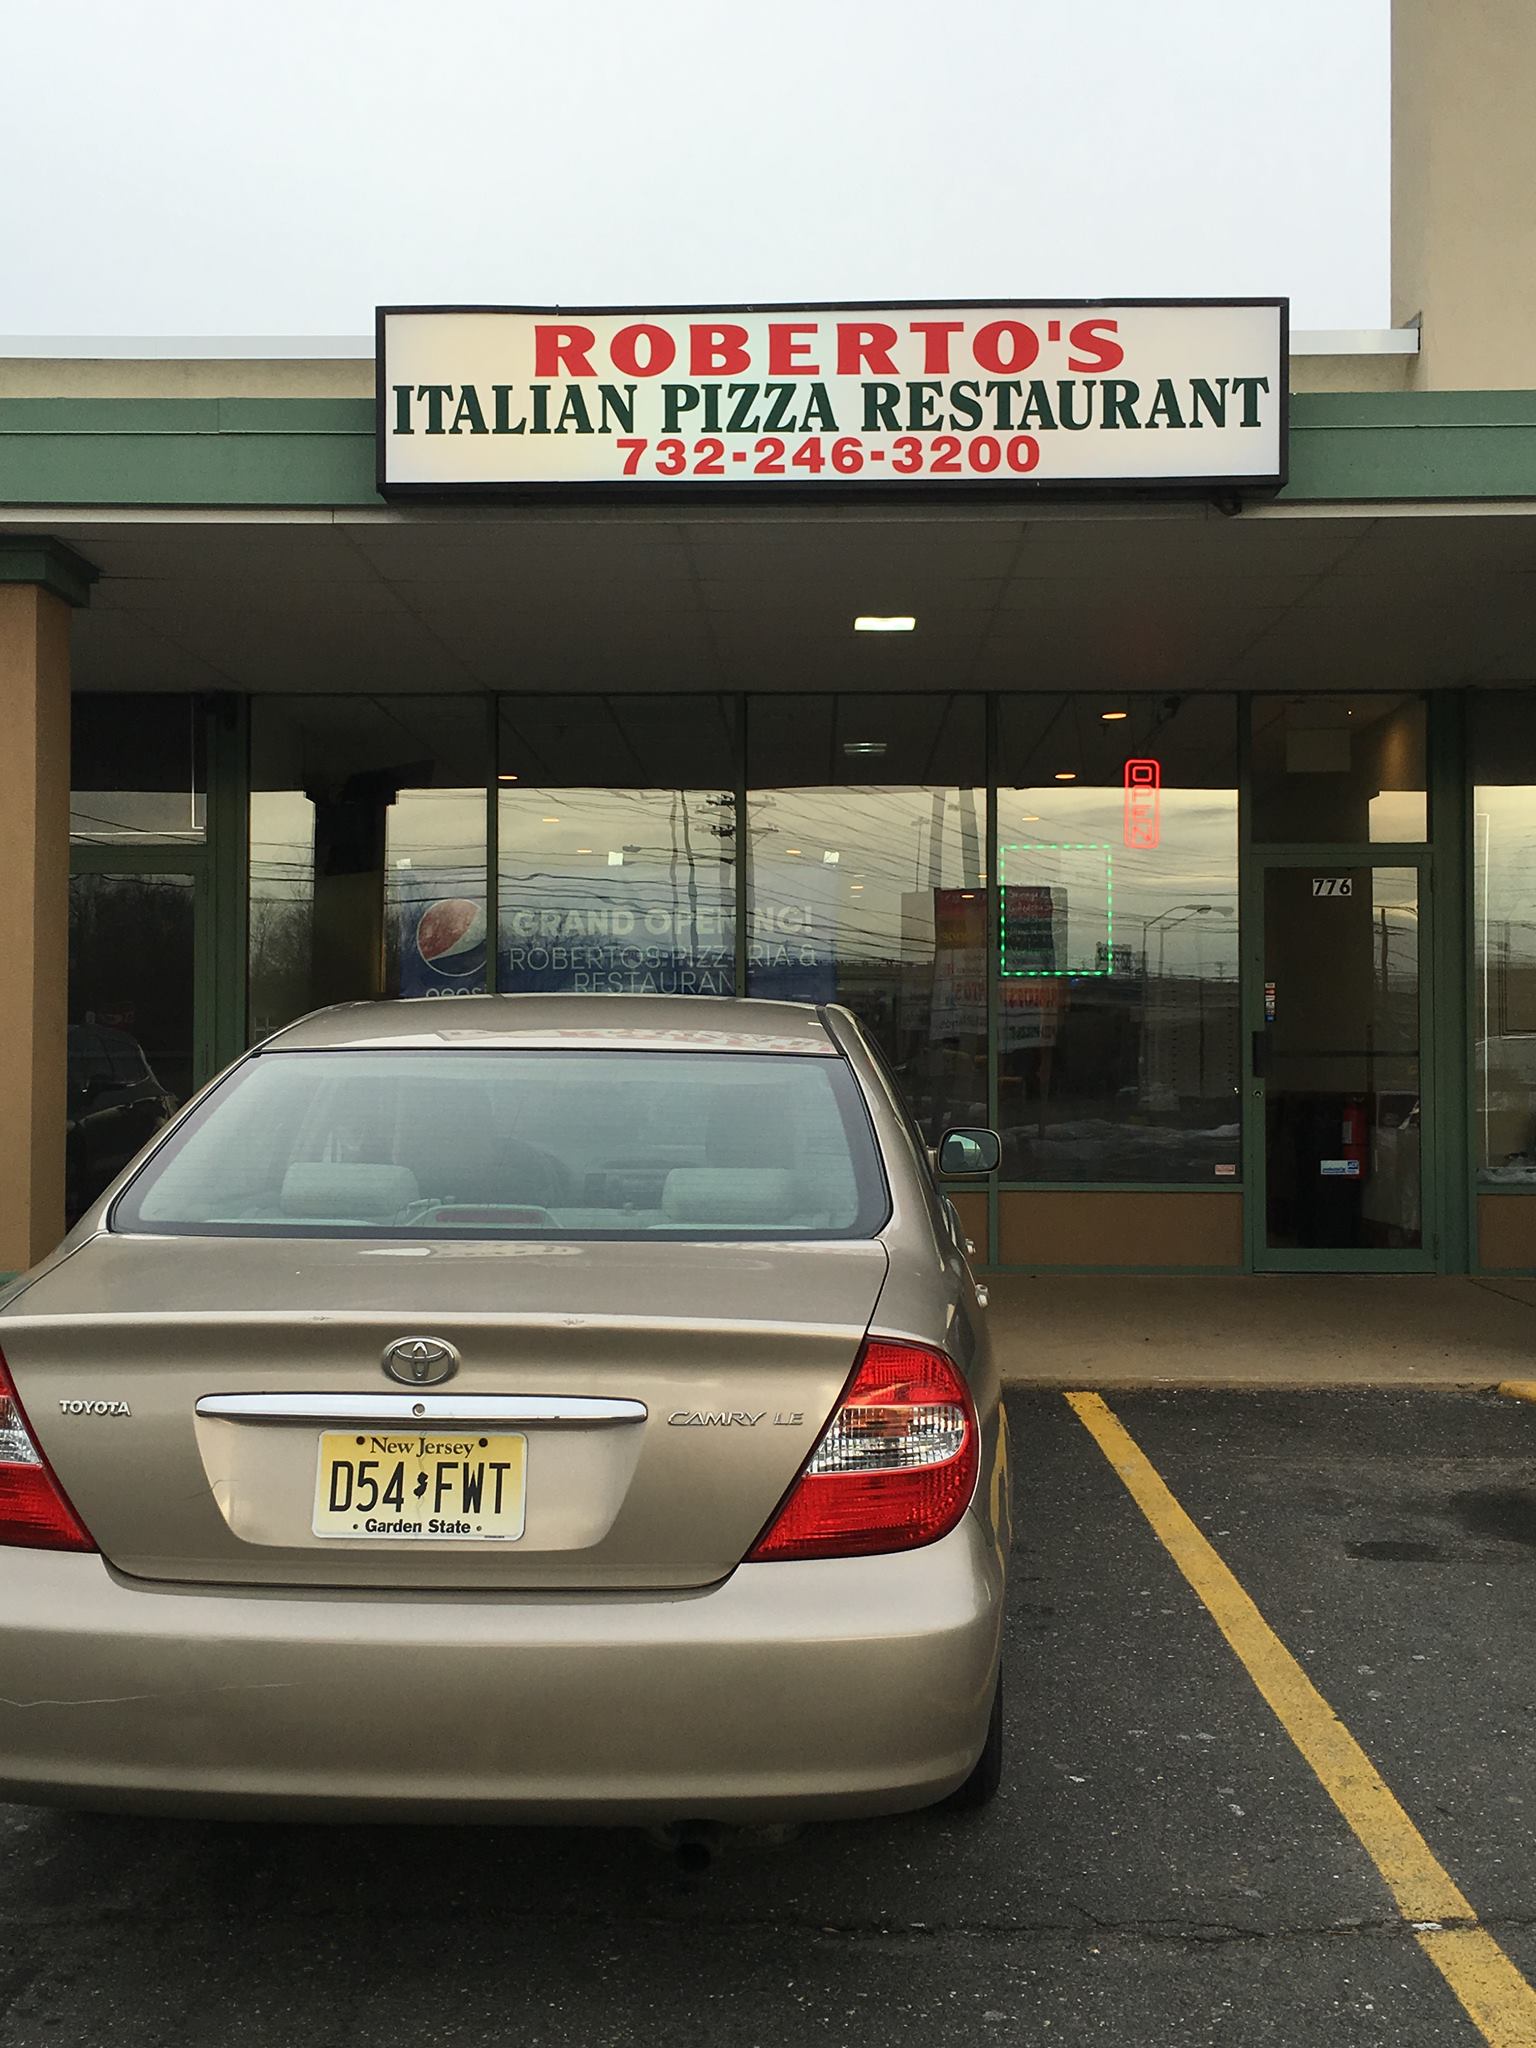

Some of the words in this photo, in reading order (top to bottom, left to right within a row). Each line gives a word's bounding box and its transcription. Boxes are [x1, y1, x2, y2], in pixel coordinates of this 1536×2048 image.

[534, 319, 1124, 377] ROBERTO'S
[393, 384, 638, 435] ITALIAN
[662, 382, 839, 434] PIZZA
[861, 376, 1270, 431] RESTAURANT
[616, 434, 1040, 476] 732-246-3200
[1131, 765, 1154, 845] OPEN
[1314, 879, 1351, 895] 776
[512, 909, 635, 937] GRAND
[644, 906, 813, 935] OPENNG!
[510, 945, 661, 970] ROBERTOS
[672, 944, 791, 968] PIZZRIA
[574, 971, 755, 994] RESTAURAN
[59, 1399, 132, 1417] TOYOTA
[667, 1410, 767, 1427] CAMRY
[773, 1412, 804, 1426] LE
[370, 1437, 413, 1454] New
[415, 1437, 474, 1458] Jersey
[329, 1461, 405, 1513] D54
[434, 1461, 511, 1514] FWT
[365, 1518, 422, 1534] Garden
[428, 1518, 471, 1534] State
